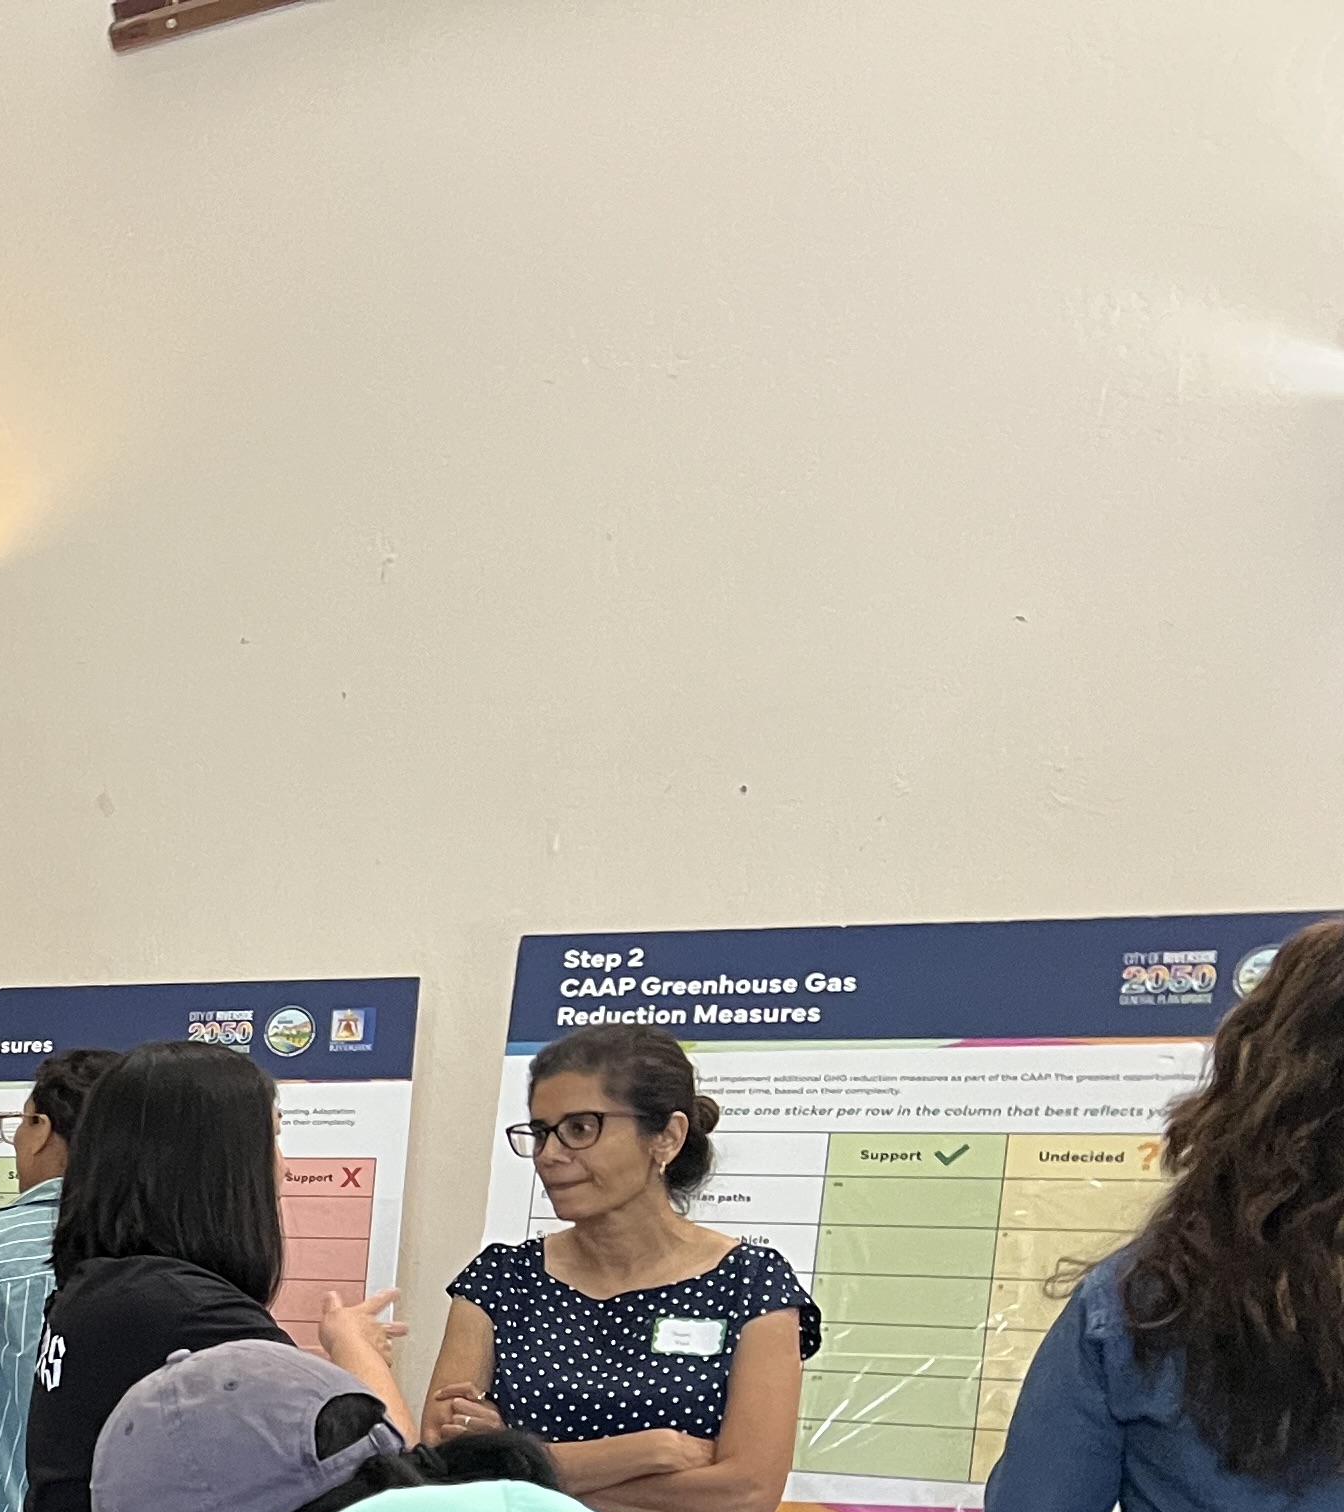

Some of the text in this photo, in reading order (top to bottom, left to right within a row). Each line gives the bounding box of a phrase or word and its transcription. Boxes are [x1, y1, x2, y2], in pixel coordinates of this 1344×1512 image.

[564, 948, 644, 972] Step 2
[560, 973, 858, 998] CAAP Greenhouse Gas
[1121, 964, 1217, 993] 2050
[557, 1004, 821, 1025] Reduction Measures
[188, 1022, 253, 1044] 2050
[721, 1105, 1167, 1120] lace one sticker per row in the column that best reflects yo
[860, 1150, 922, 1162] Support
[1039, 1151, 1125, 1163] Undecided
[285, 1172, 333, 1184] Support
[718, 1194, 751, 1204] paths
